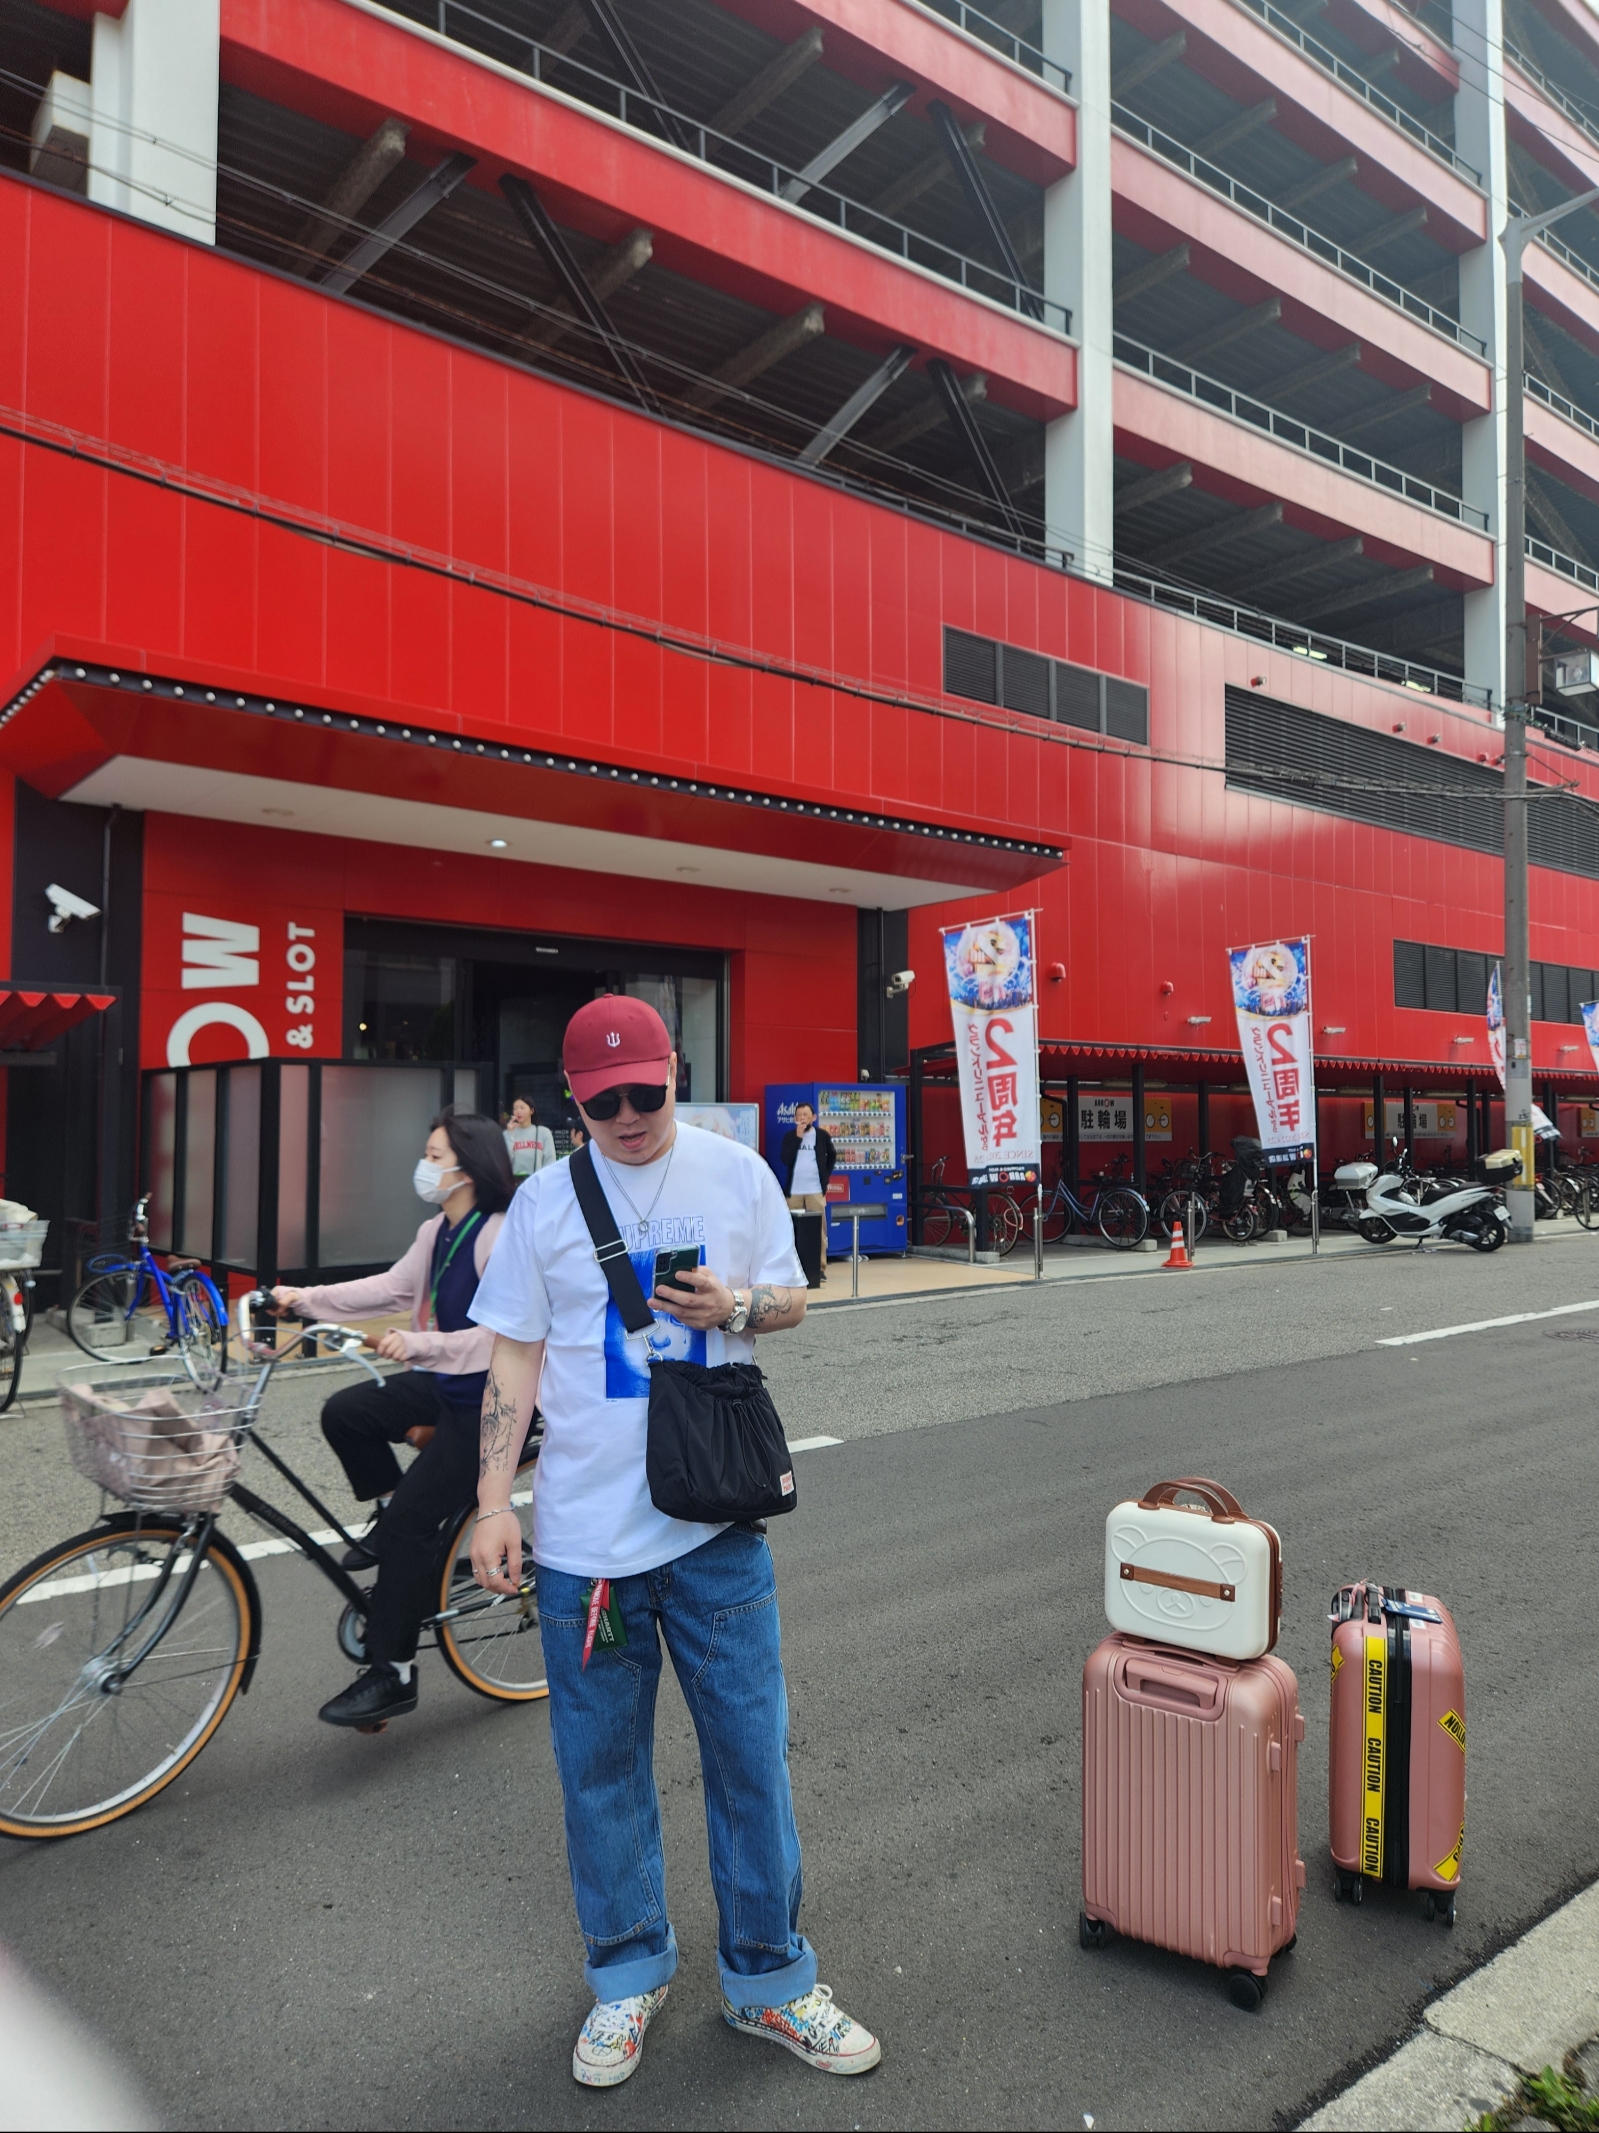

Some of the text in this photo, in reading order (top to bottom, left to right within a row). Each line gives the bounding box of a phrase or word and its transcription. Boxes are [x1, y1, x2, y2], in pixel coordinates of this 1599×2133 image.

[285, 921, 316, 1049] & SLOT
[1081, 1109, 1127, 1130] 駐輪場
[619, 1216, 706, 1251] UPREME
[1368, 1659, 1382, 1714] CAUTION
[1367, 1738, 1381, 1792] CAUTION
[1365, 1817, 1380, 1872] CAUTION
